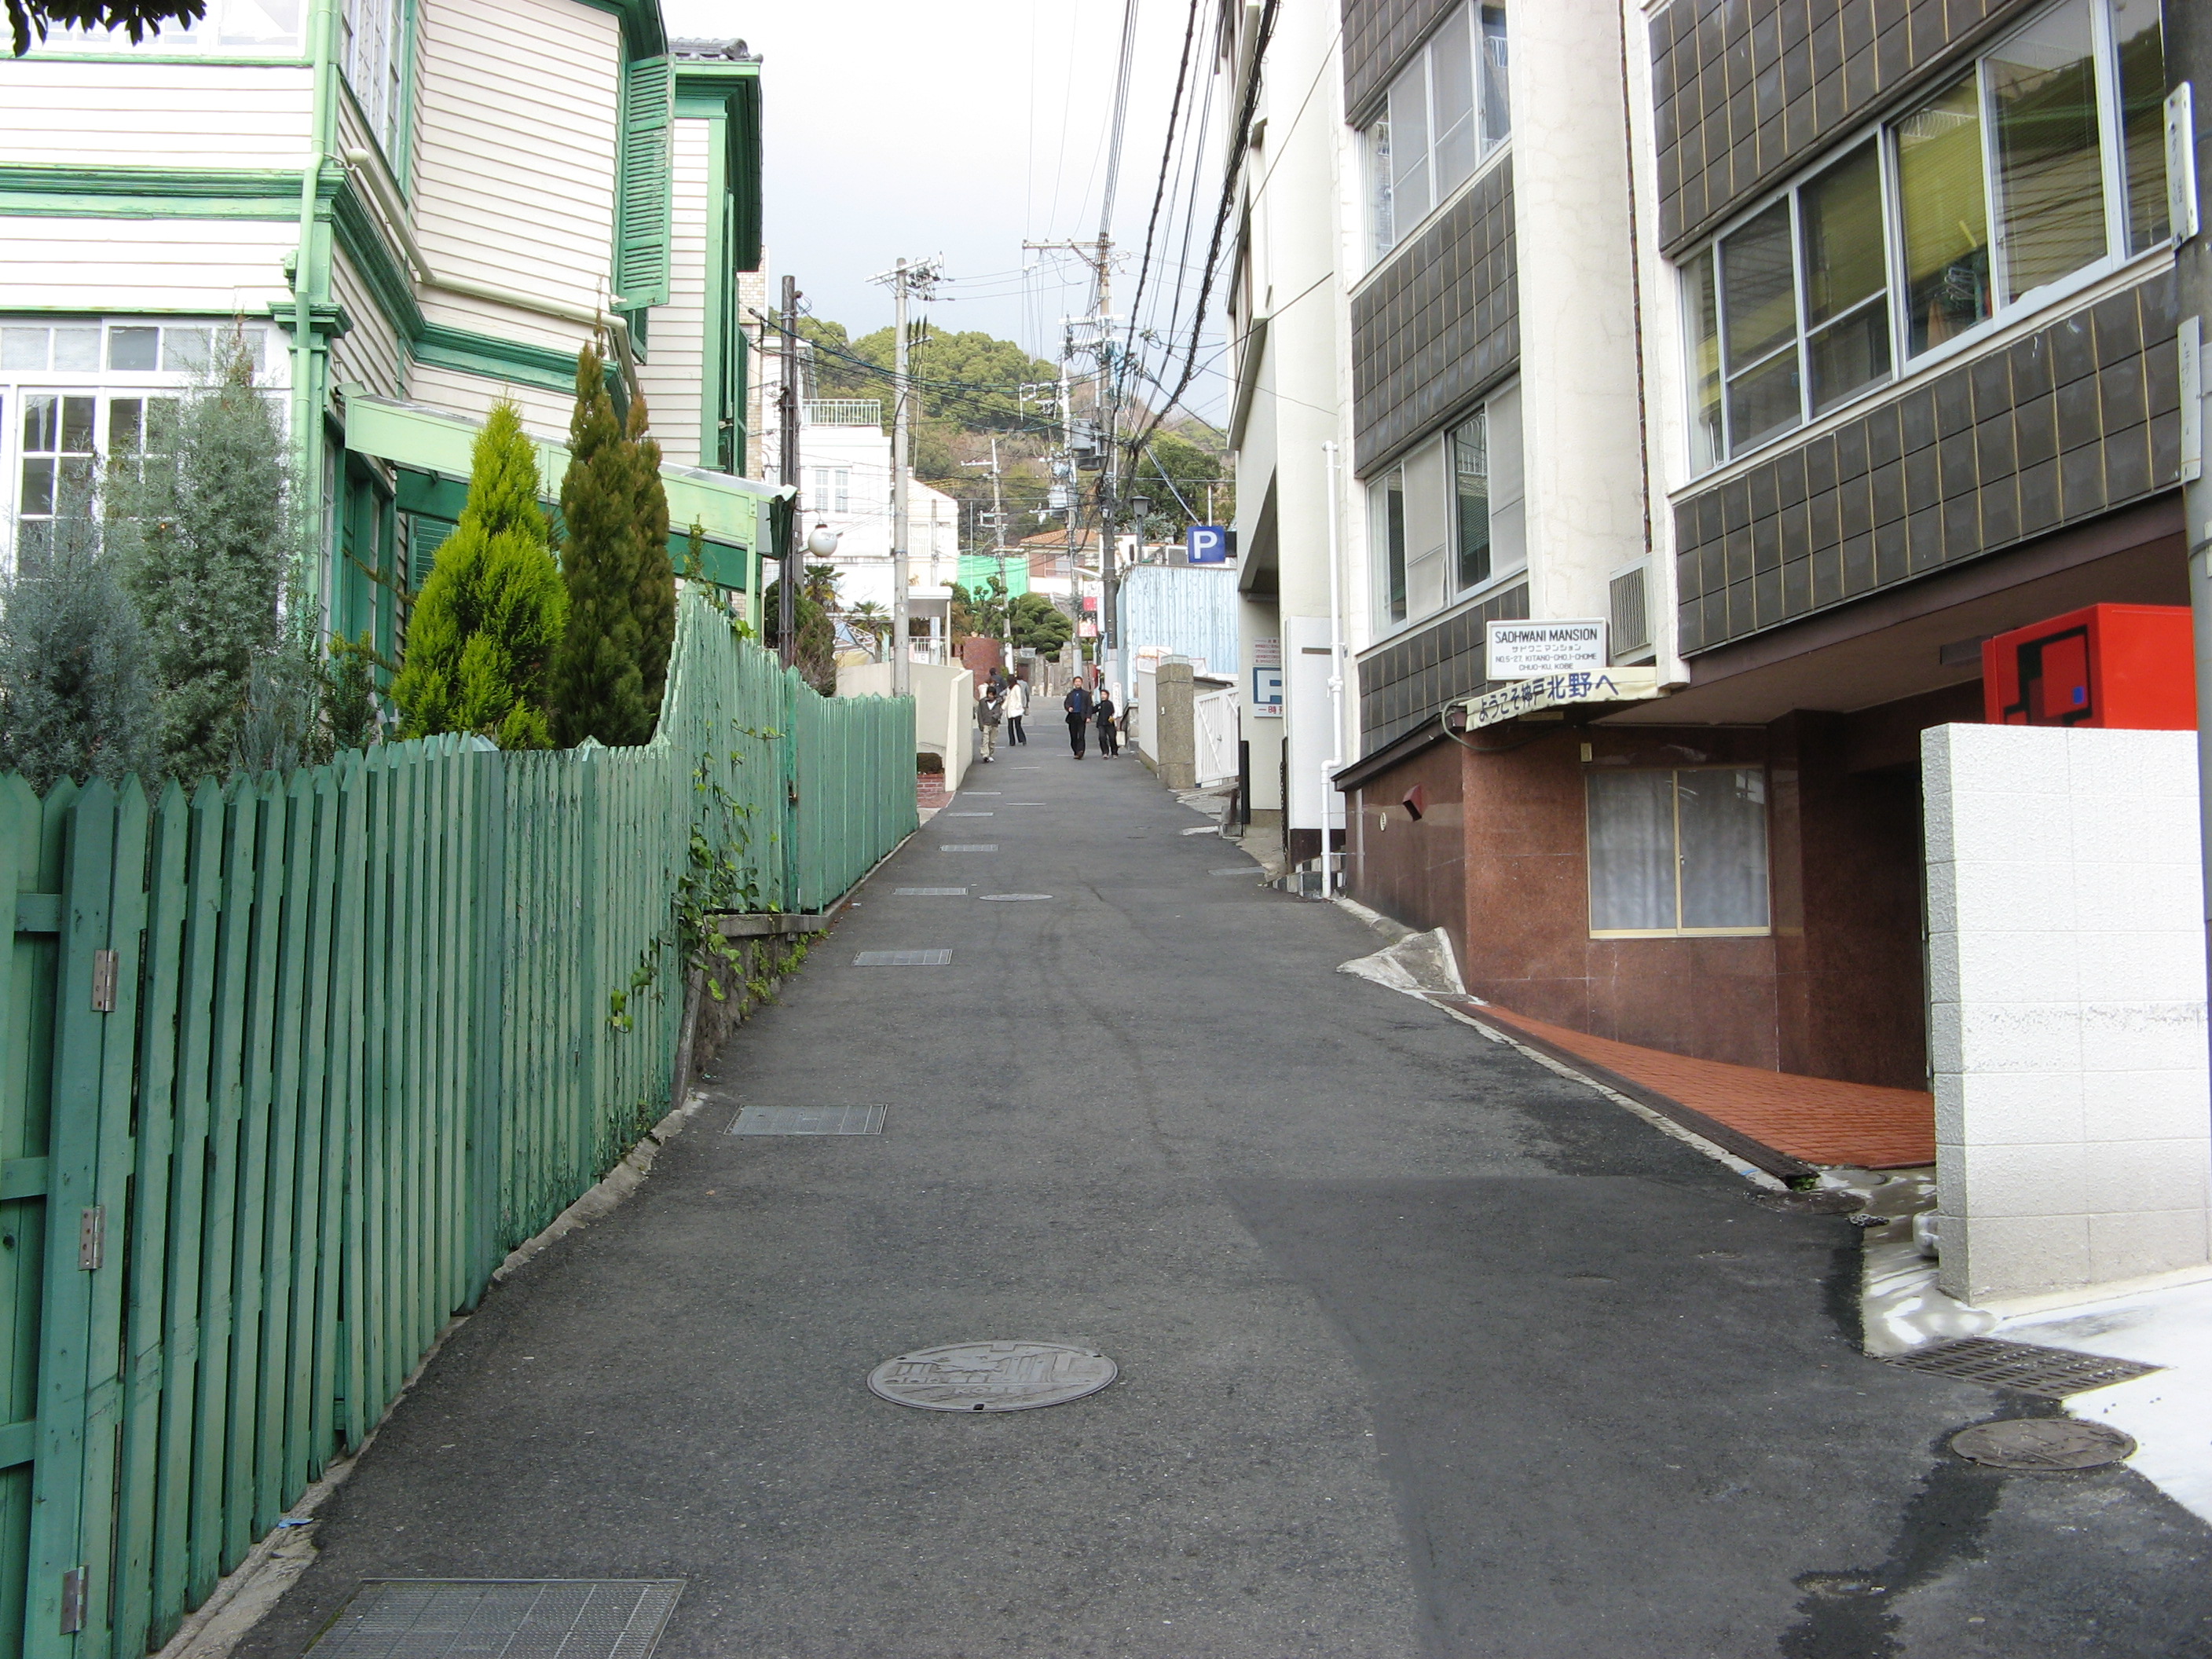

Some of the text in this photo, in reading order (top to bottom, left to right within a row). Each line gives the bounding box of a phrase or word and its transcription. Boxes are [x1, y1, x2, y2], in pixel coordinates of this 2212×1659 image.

[1193, 530, 1218, 559] P
[1495, 628, 1598, 643] SADHWANI MANSION
